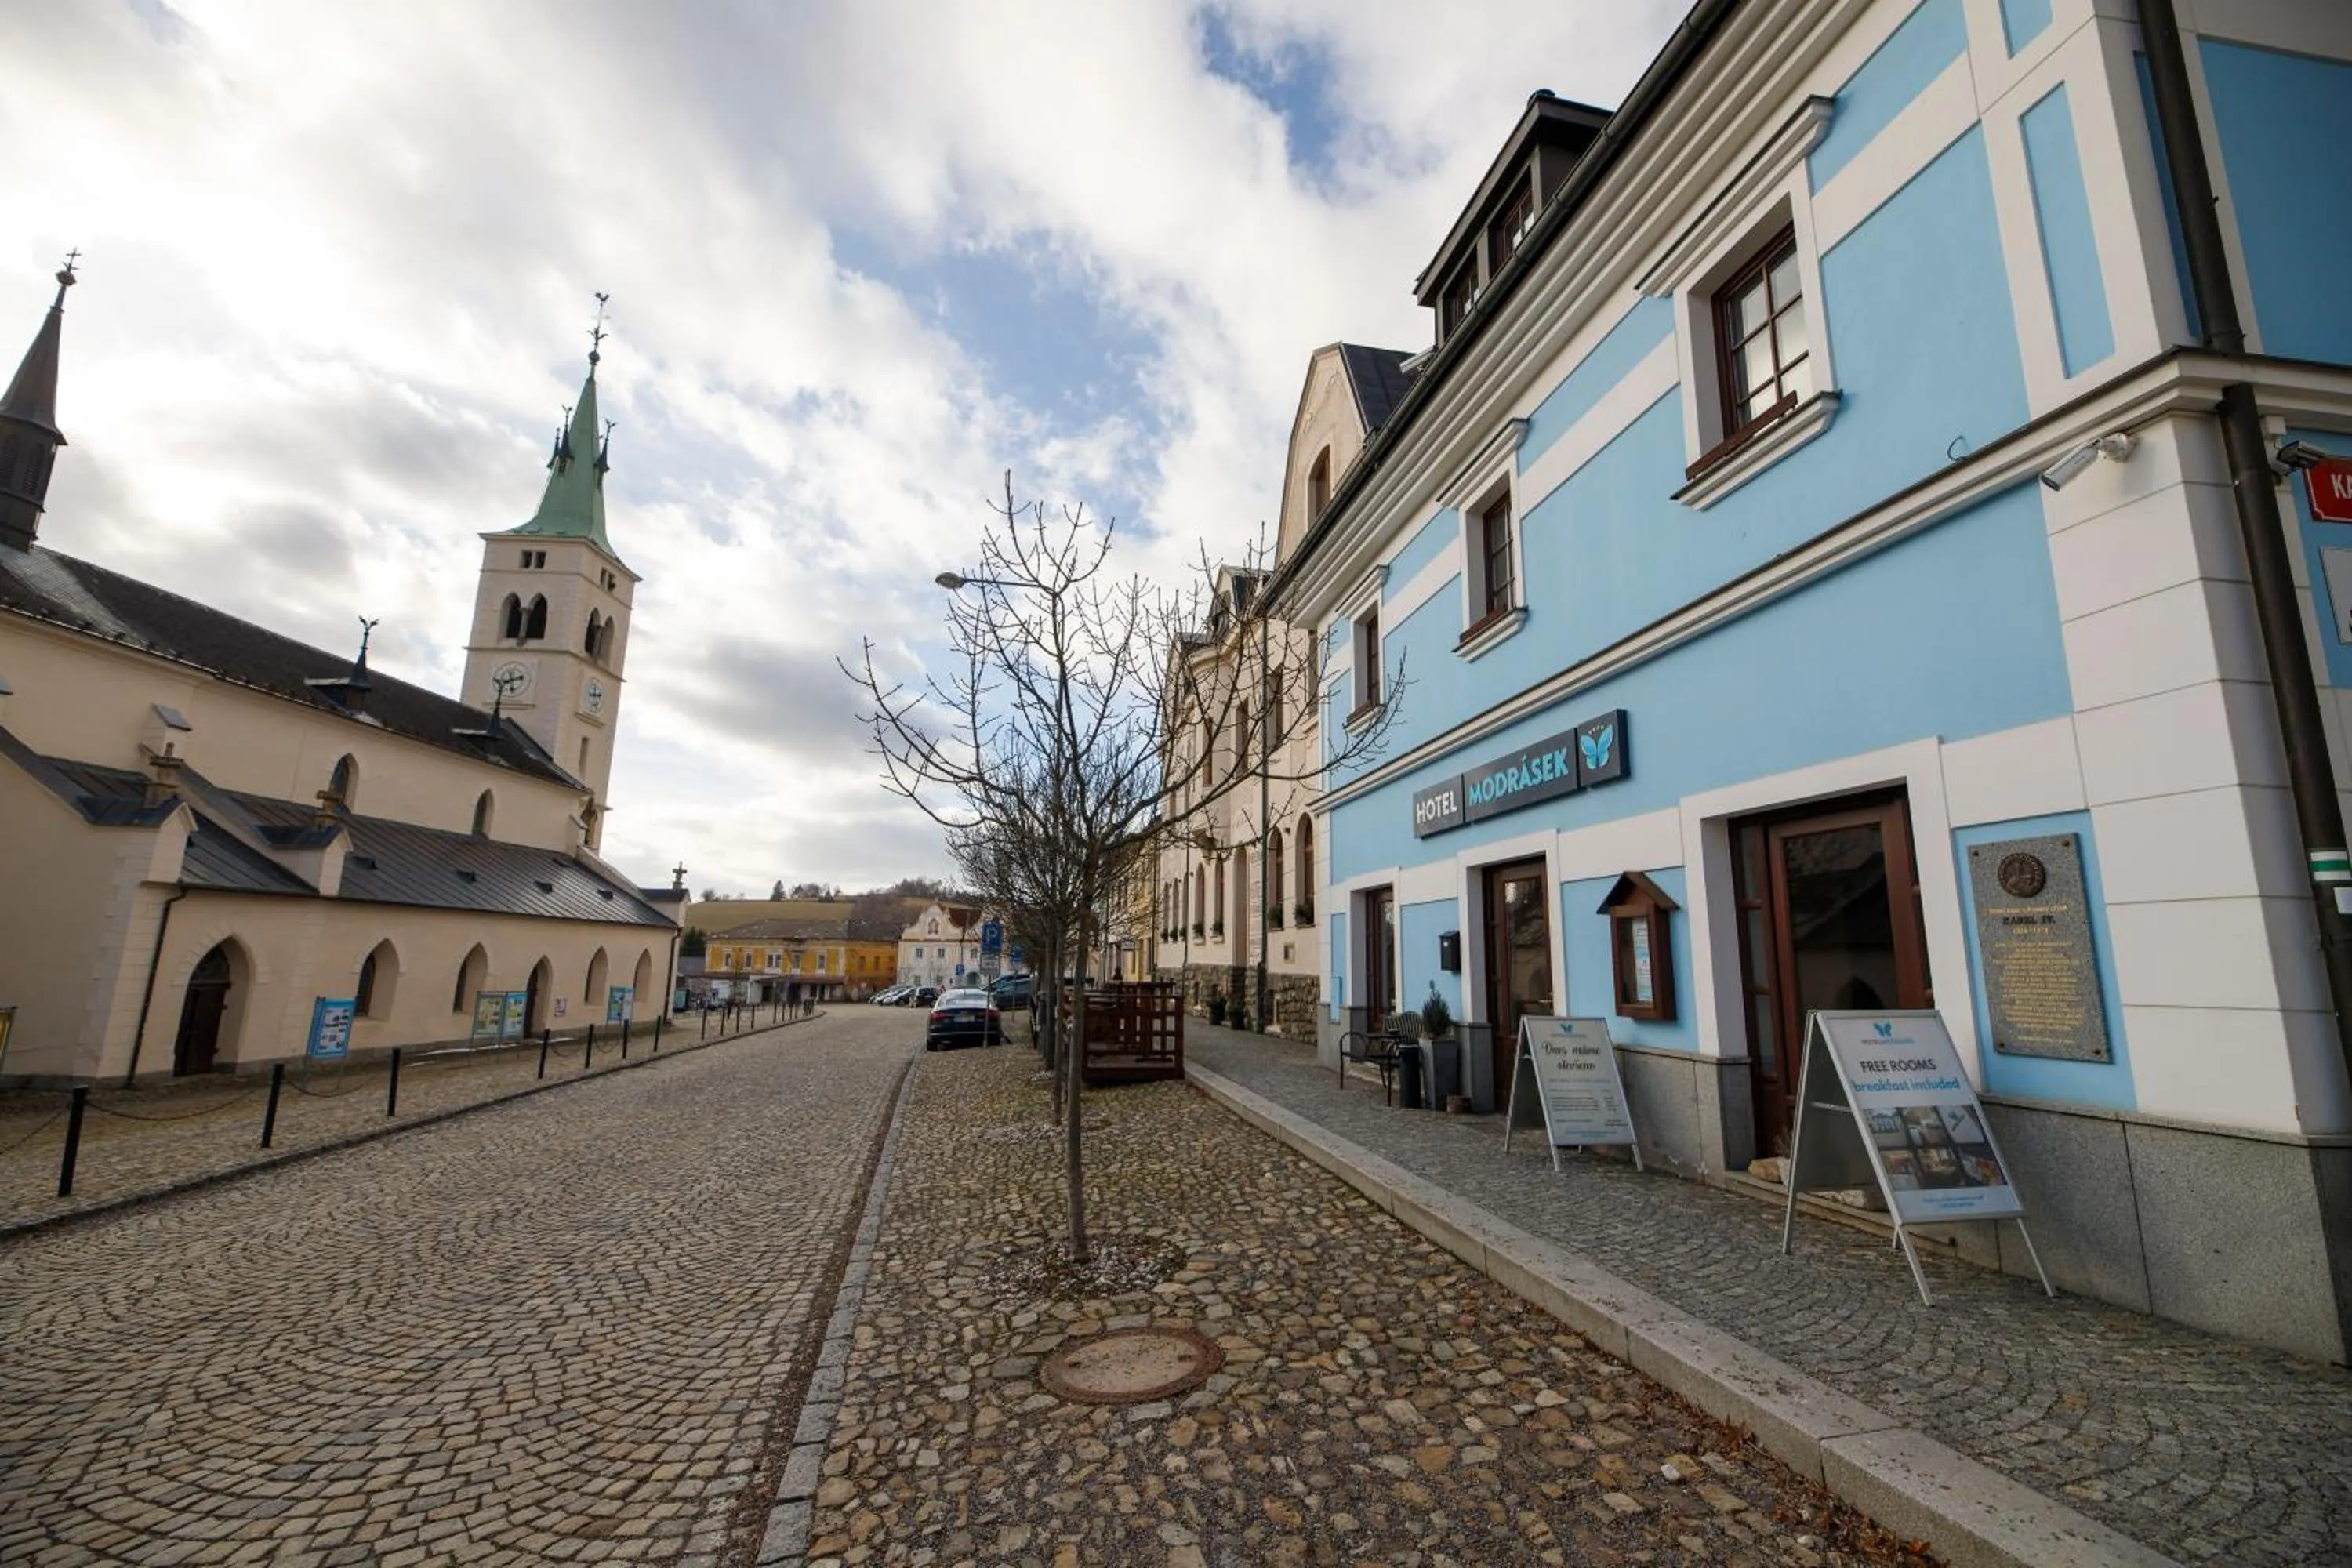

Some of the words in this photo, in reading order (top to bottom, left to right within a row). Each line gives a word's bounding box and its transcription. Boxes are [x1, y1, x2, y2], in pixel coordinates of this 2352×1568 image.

[1416, 789, 1457, 824] HOTEL
[1468, 746, 1569, 806] MODRÁSEK
[985, 926, 999, 942] P
[1859, 1059, 1889, 1073] FREE
[1889, 1058, 1937, 1073] ROOMS
[1851, 1078, 1910, 1092] breakfast
[1911, 1076, 1959, 1091] included
